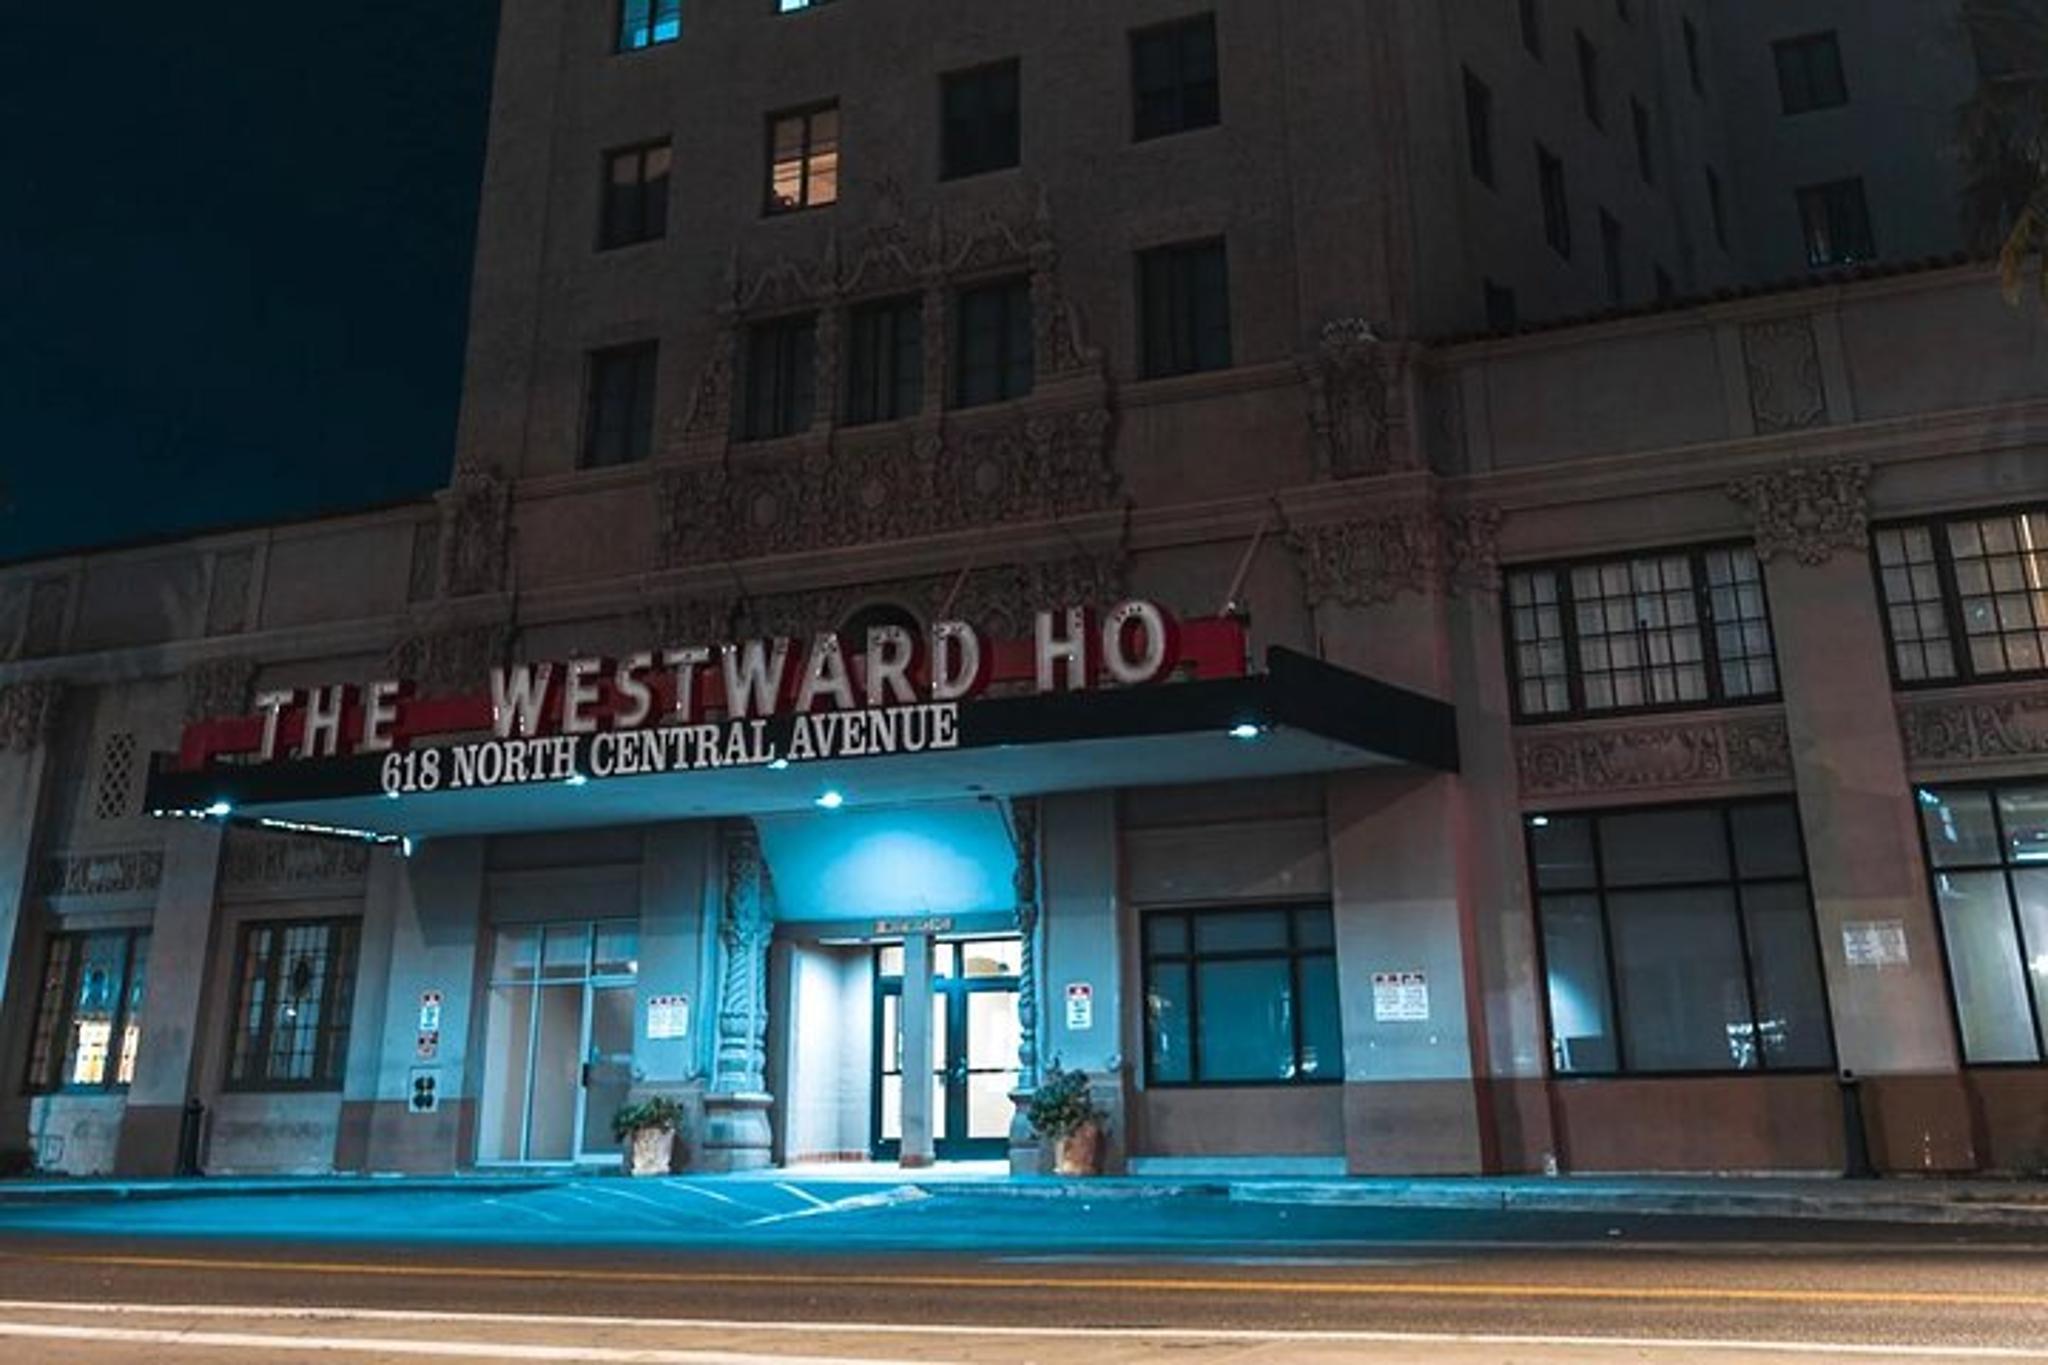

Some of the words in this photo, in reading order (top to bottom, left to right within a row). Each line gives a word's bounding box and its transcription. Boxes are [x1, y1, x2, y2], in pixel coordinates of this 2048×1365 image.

[257, 681, 400, 760] THE
[490, 621, 981, 736] WESTWARD
[1034, 600, 1167, 691] HO
[381, 748, 440, 792] 618
[449, 734, 577, 788] NORTH
[588, 719, 775, 776] CENTRAL
[787, 702, 959, 760] AVENUE
